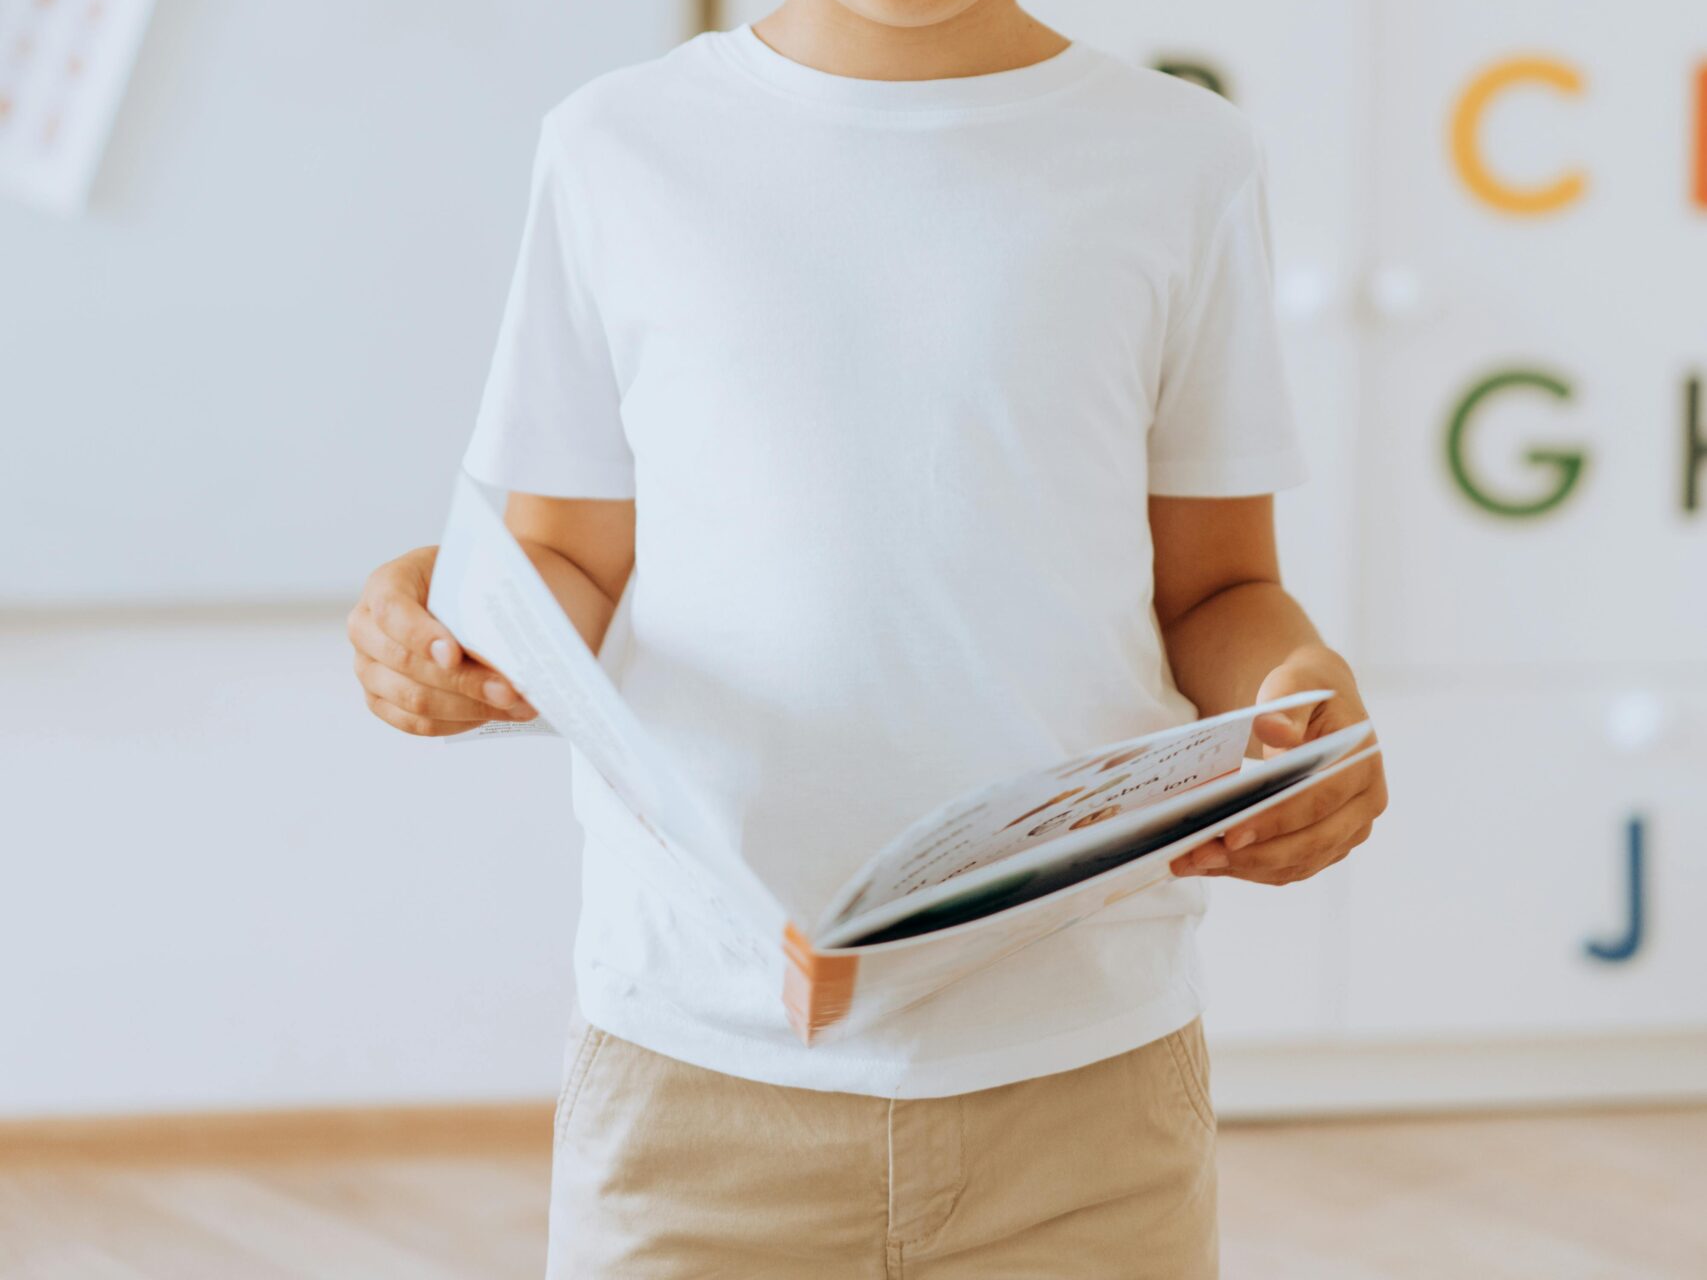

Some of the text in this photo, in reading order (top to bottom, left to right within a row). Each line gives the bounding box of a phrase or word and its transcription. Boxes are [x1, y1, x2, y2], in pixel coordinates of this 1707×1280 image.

[1446, 53, 1588, 219] C
[1441, 366, 1589, 522] G
[1584, 815, 1650, 966] J
